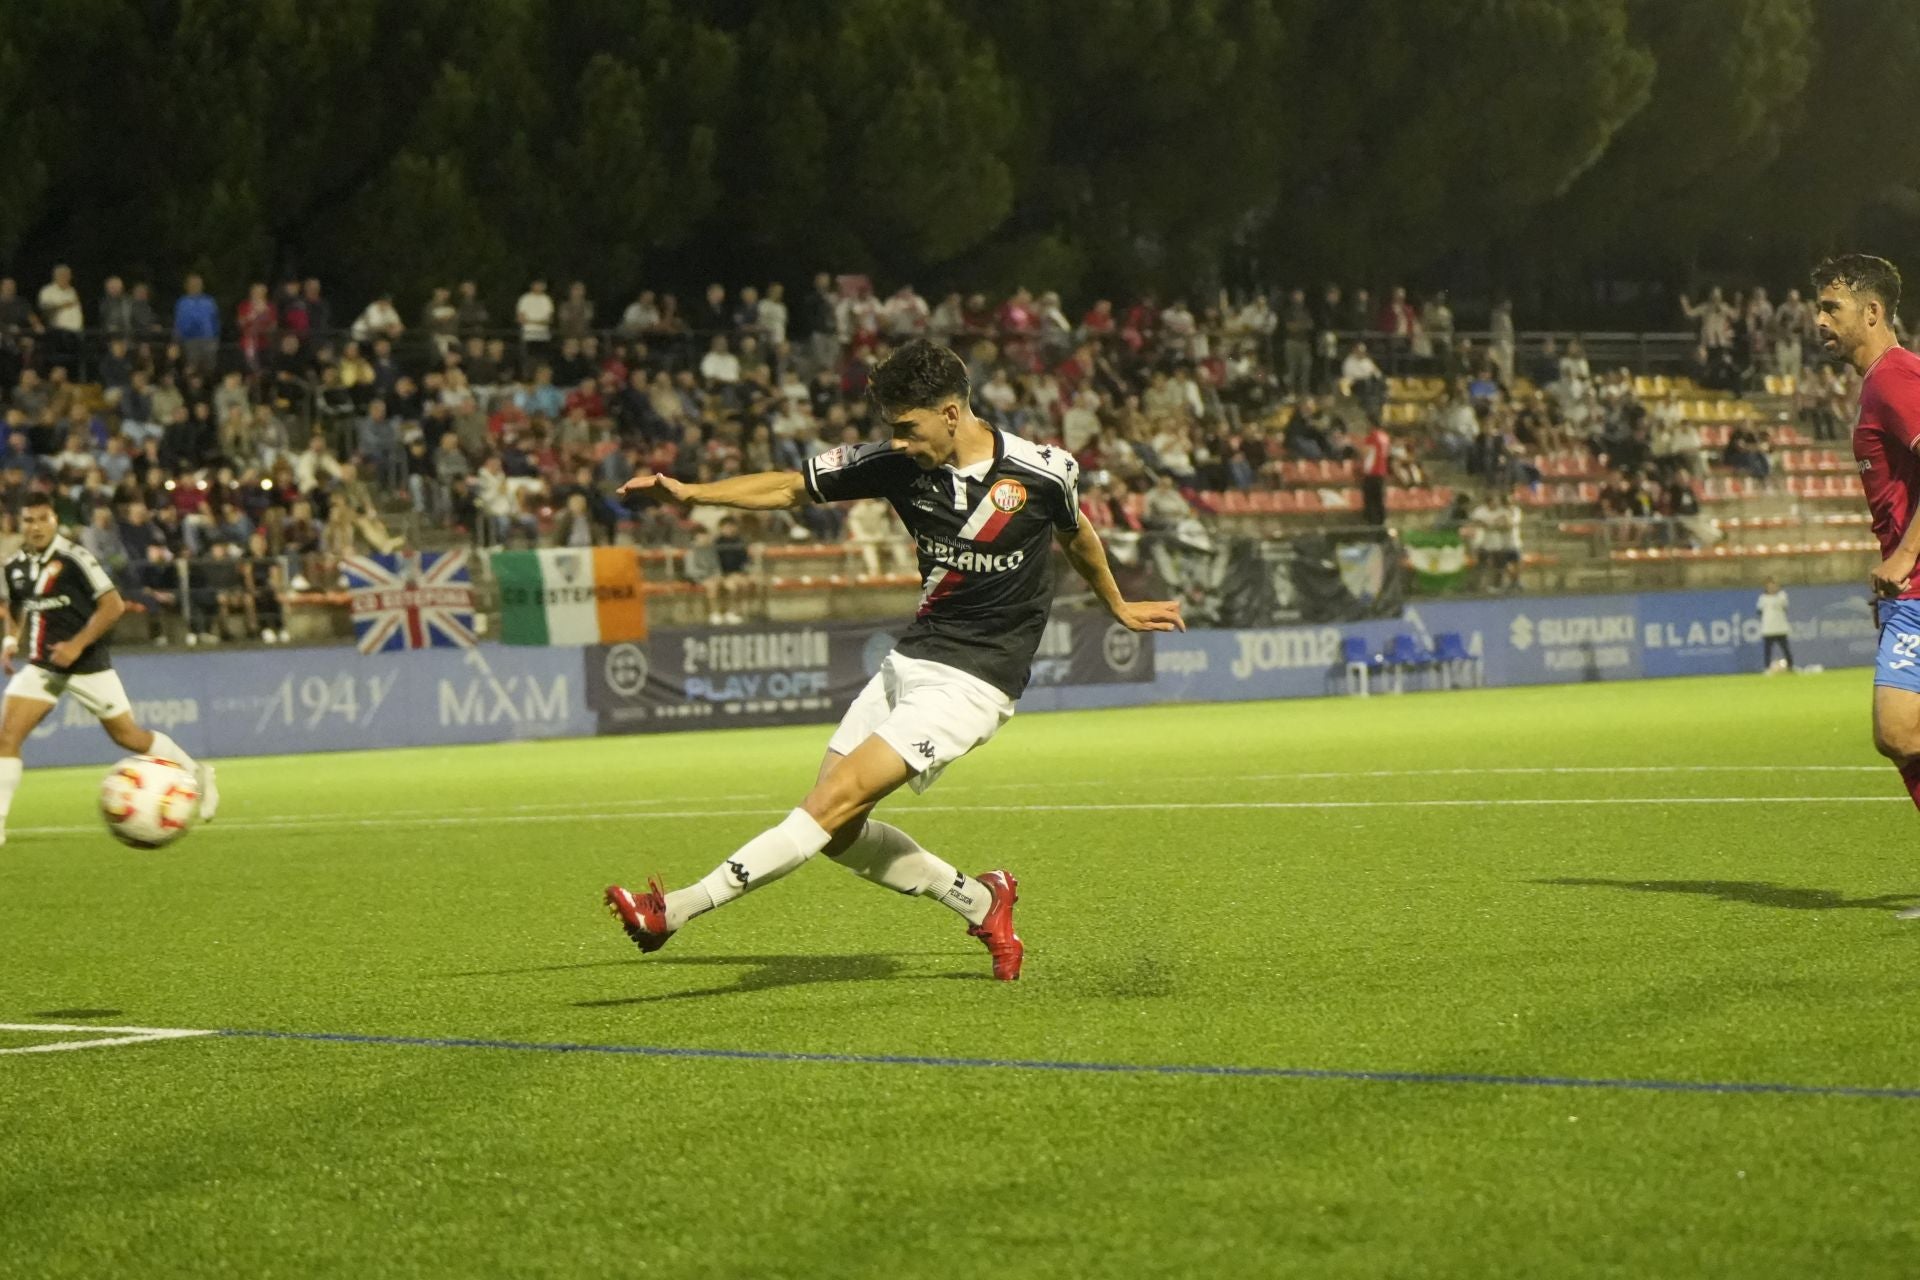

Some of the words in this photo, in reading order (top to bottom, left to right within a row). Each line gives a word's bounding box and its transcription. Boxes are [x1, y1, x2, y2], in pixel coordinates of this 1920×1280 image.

[934, 535, 972, 551] embalajes
[935, 541, 1024, 573] BLANCO
[1538, 615, 1637, 647] SUZUKI
[1892, 632, 1920, 658] 22
[683, 673, 762, 702] PLAY
[766, 670, 829, 698] OFF
